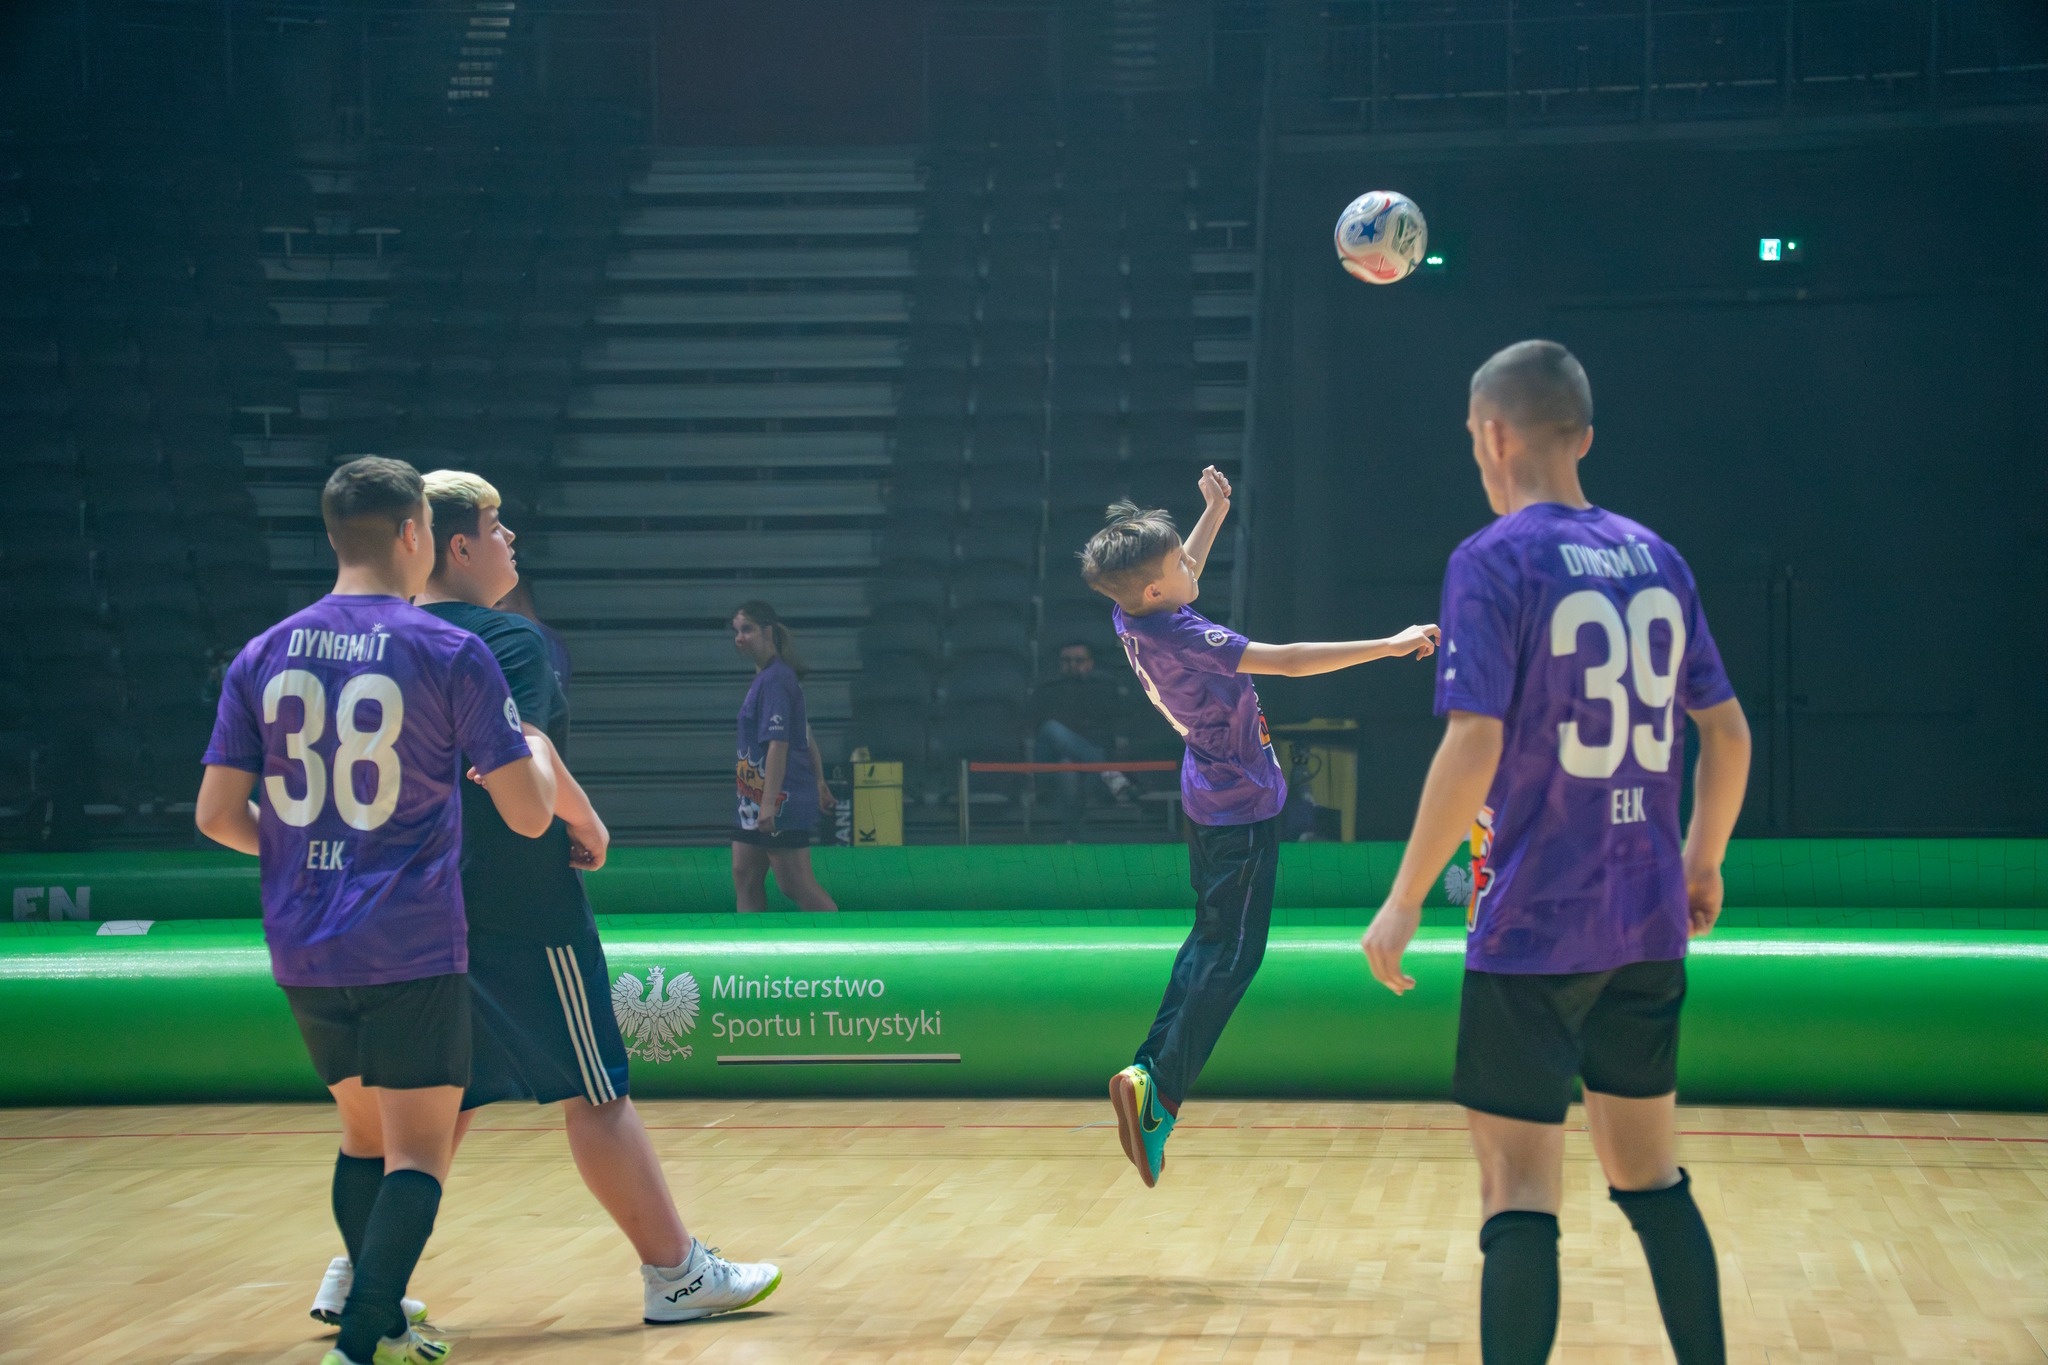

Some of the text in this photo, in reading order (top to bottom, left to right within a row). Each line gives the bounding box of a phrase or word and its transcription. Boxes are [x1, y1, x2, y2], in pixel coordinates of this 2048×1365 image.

[287, 627, 390, 662] DYNAMIT
[1551, 587, 1686, 778] 39
[263, 669, 403, 831] 38
[1610, 786, 1647, 825] EŁK
[307, 840, 346, 870] EŁK
[711, 974, 886, 1000] Ministerstwo
[711, 1009, 942, 1043] Sportu i Turystyki
